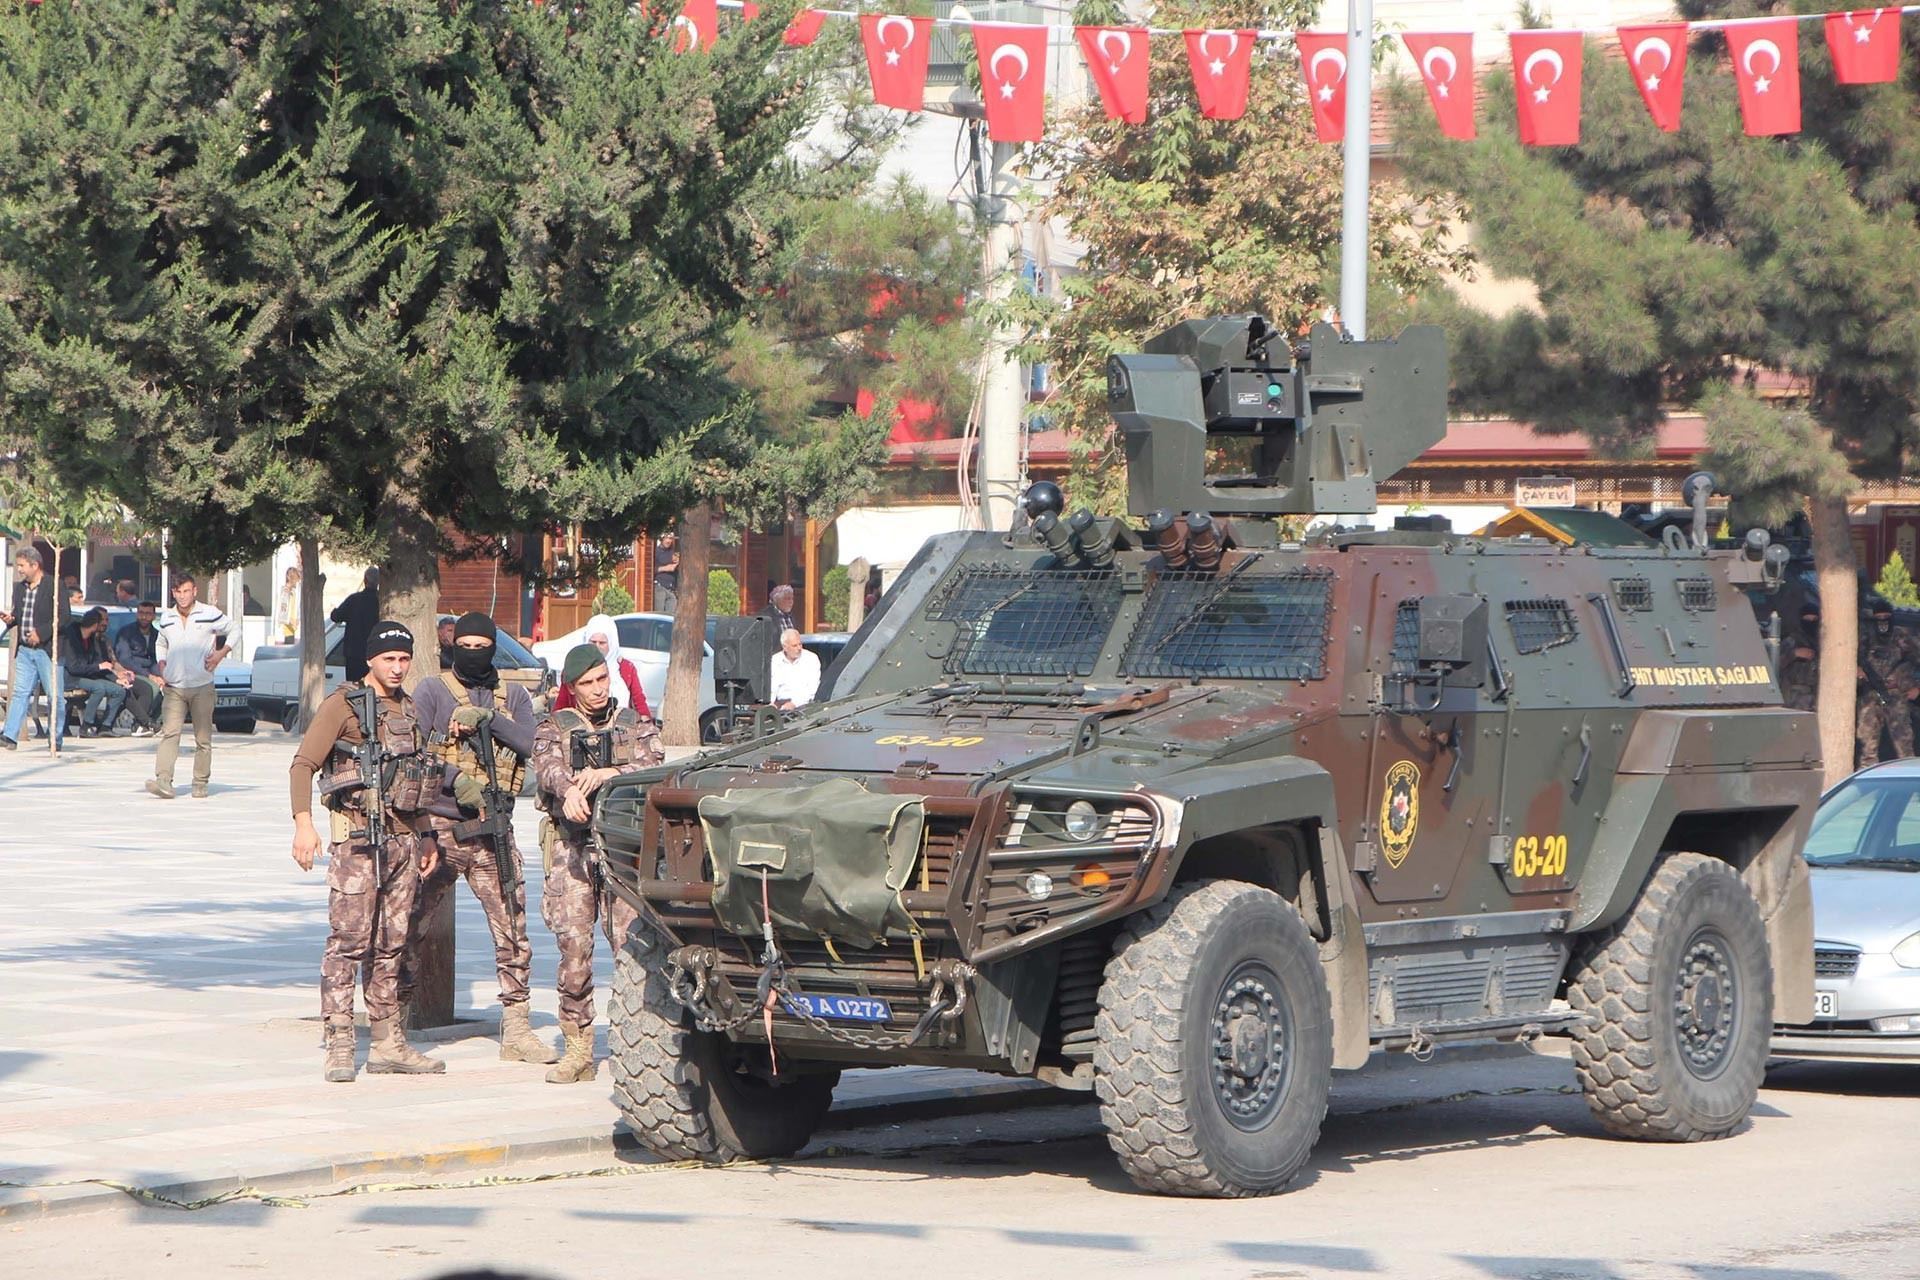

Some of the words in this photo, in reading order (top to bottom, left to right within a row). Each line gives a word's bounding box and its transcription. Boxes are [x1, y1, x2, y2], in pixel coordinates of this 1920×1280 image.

[1522, 491, 1545, 502] ÇAY
[1653, 667, 1718, 686] MUSTAFA
[875, 735, 985, 747] 63-20
[1513, 835, 1568, 878] 63-20
[819, 998, 835, 1015] A
[836, 999, 888, 1019] 0272
